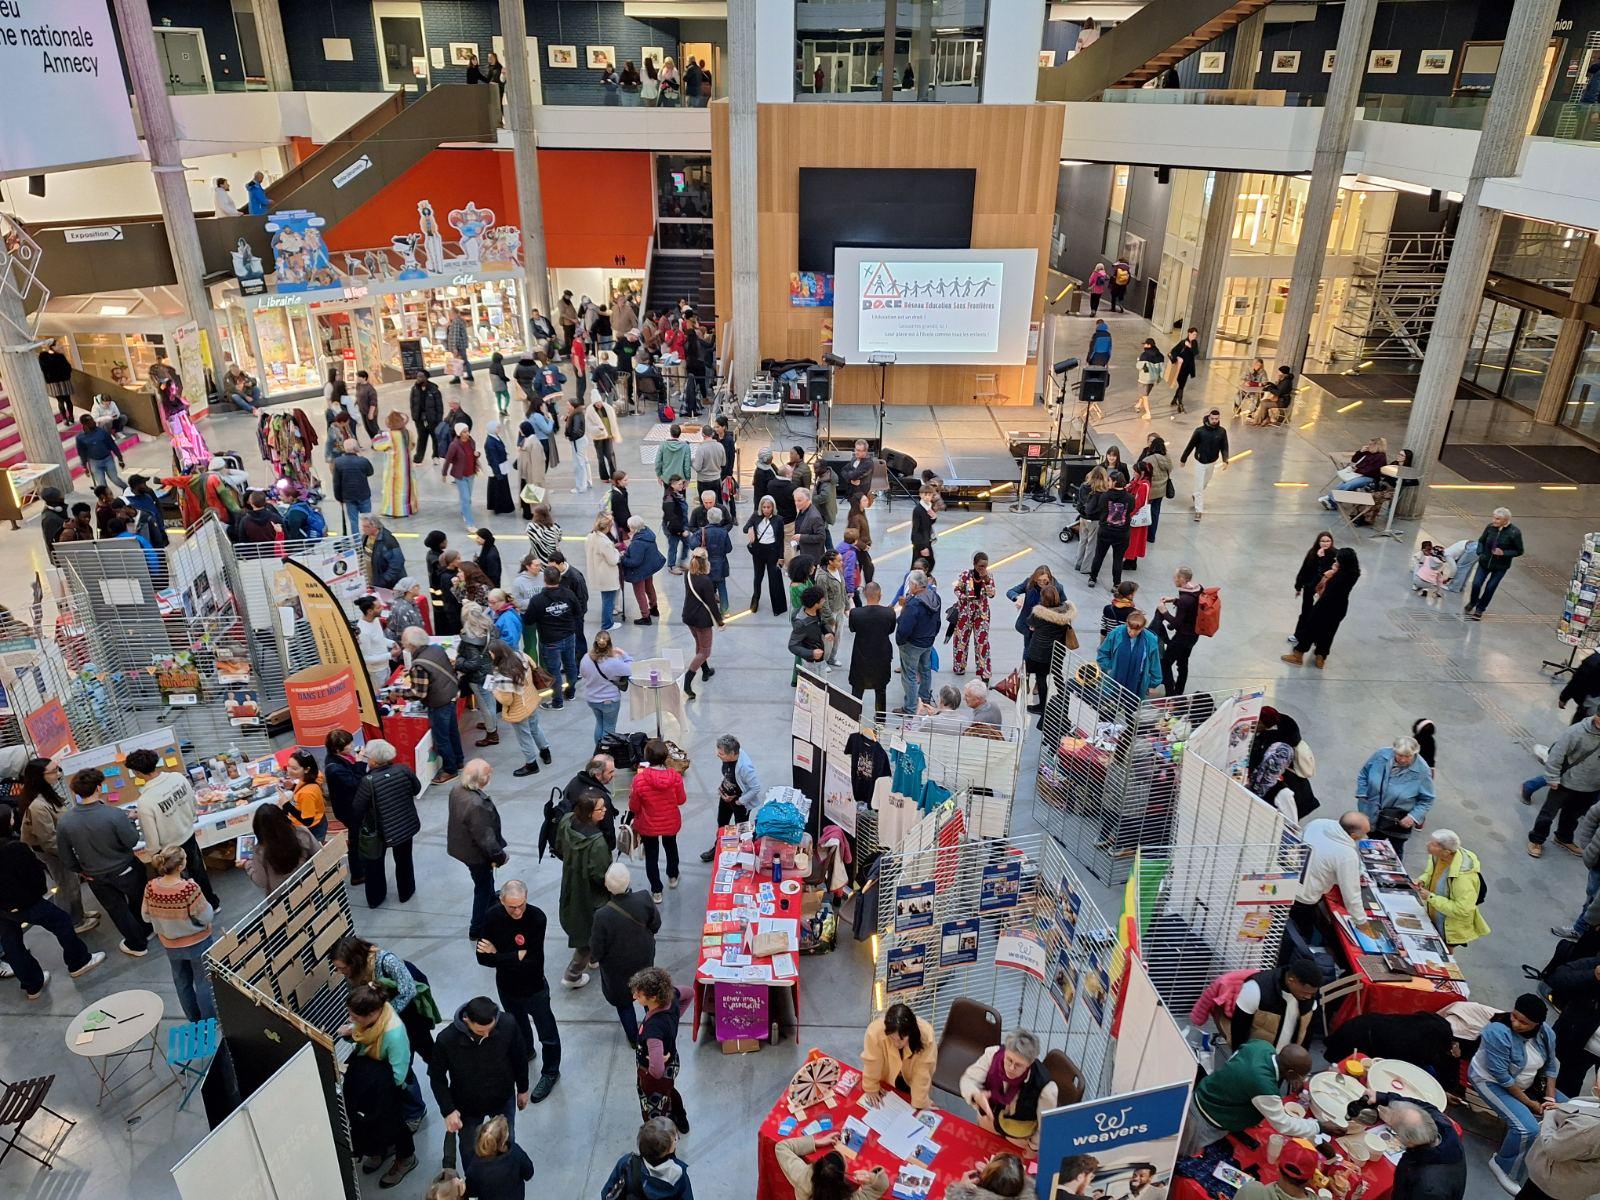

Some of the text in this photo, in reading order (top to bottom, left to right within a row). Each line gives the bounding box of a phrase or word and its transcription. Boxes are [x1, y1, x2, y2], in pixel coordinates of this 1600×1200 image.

[20, 24, 94, 47] nationale
[43, 51, 98, 77] Annecy
[71, 231, 109, 240] Exposition
[258, 294, 301, 308] Librairie
[953, 300, 966, 309] Sans
[966, 300, 995, 309] Frontières
[1008, 952, 1039, 966] weavers
[1072, 1122, 1148, 1146] weavers
